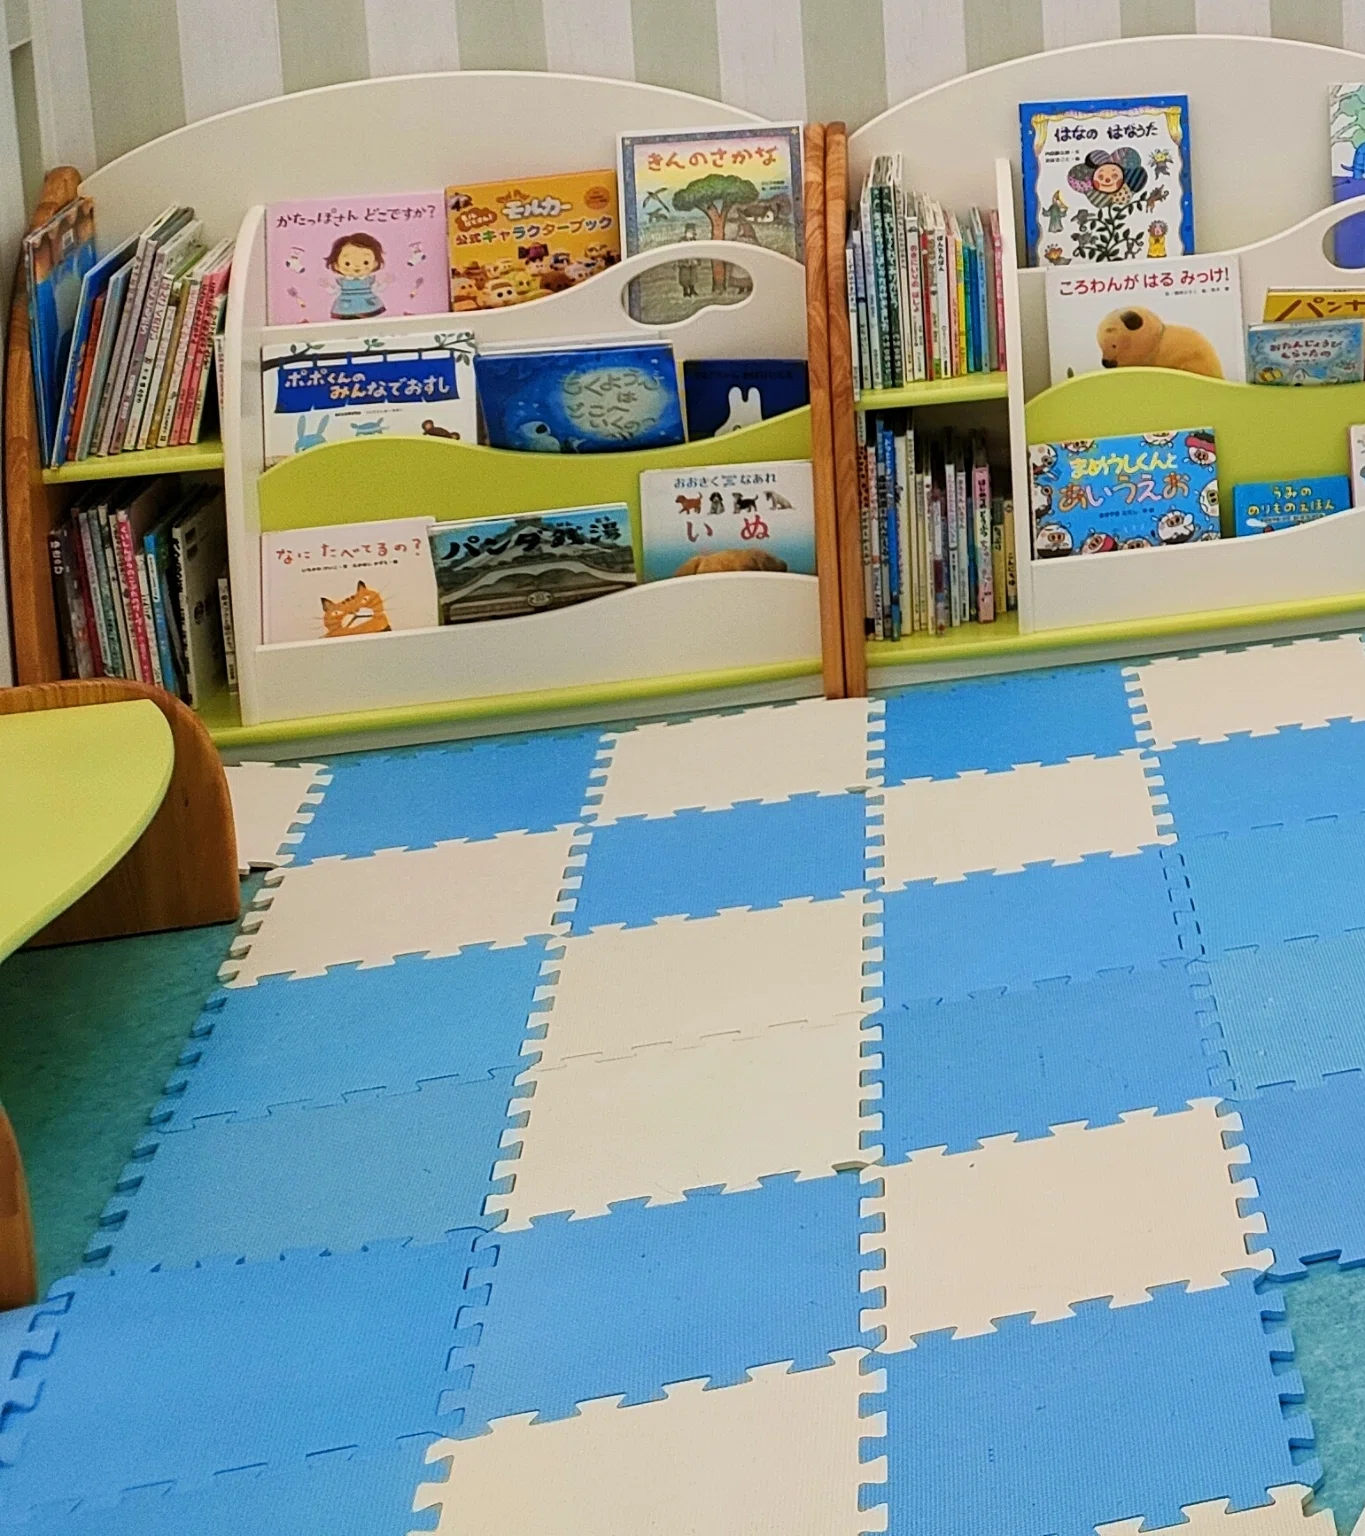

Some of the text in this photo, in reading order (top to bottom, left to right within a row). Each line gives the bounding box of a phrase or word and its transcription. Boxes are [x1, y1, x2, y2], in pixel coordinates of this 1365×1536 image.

[1053, 120, 1159, 143] はなの はなうた
[647, 145, 778, 172] きんのさかな
[275, 207, 359, 229] かたっぽさん
[363, 204, 437, 224] どこですか？
[502, 196, 573, 220] モルカー
[454, 216, 614, 246] 公式キャラクターブック
[1059, 274, 1140, 296] ころわんが
[1143, 271, 1175, 289] はる
[284, 368, 366, 389] ポポくんの
[329, 375, 451, 400] みんなでおすし
[1069, 451, 1178, 479] まめうしくんと
[674, 472, 777, 489] おおきく なあれ
[1058, 471, 1191, 513] あいうえお
[1272, 484, 1312, 499] うみの
[441, 515, 623, 561] パンダ銭湯
[685, 514, 770, 543] いぬ
[274, 537, 422, 565] なに たべてるの？
